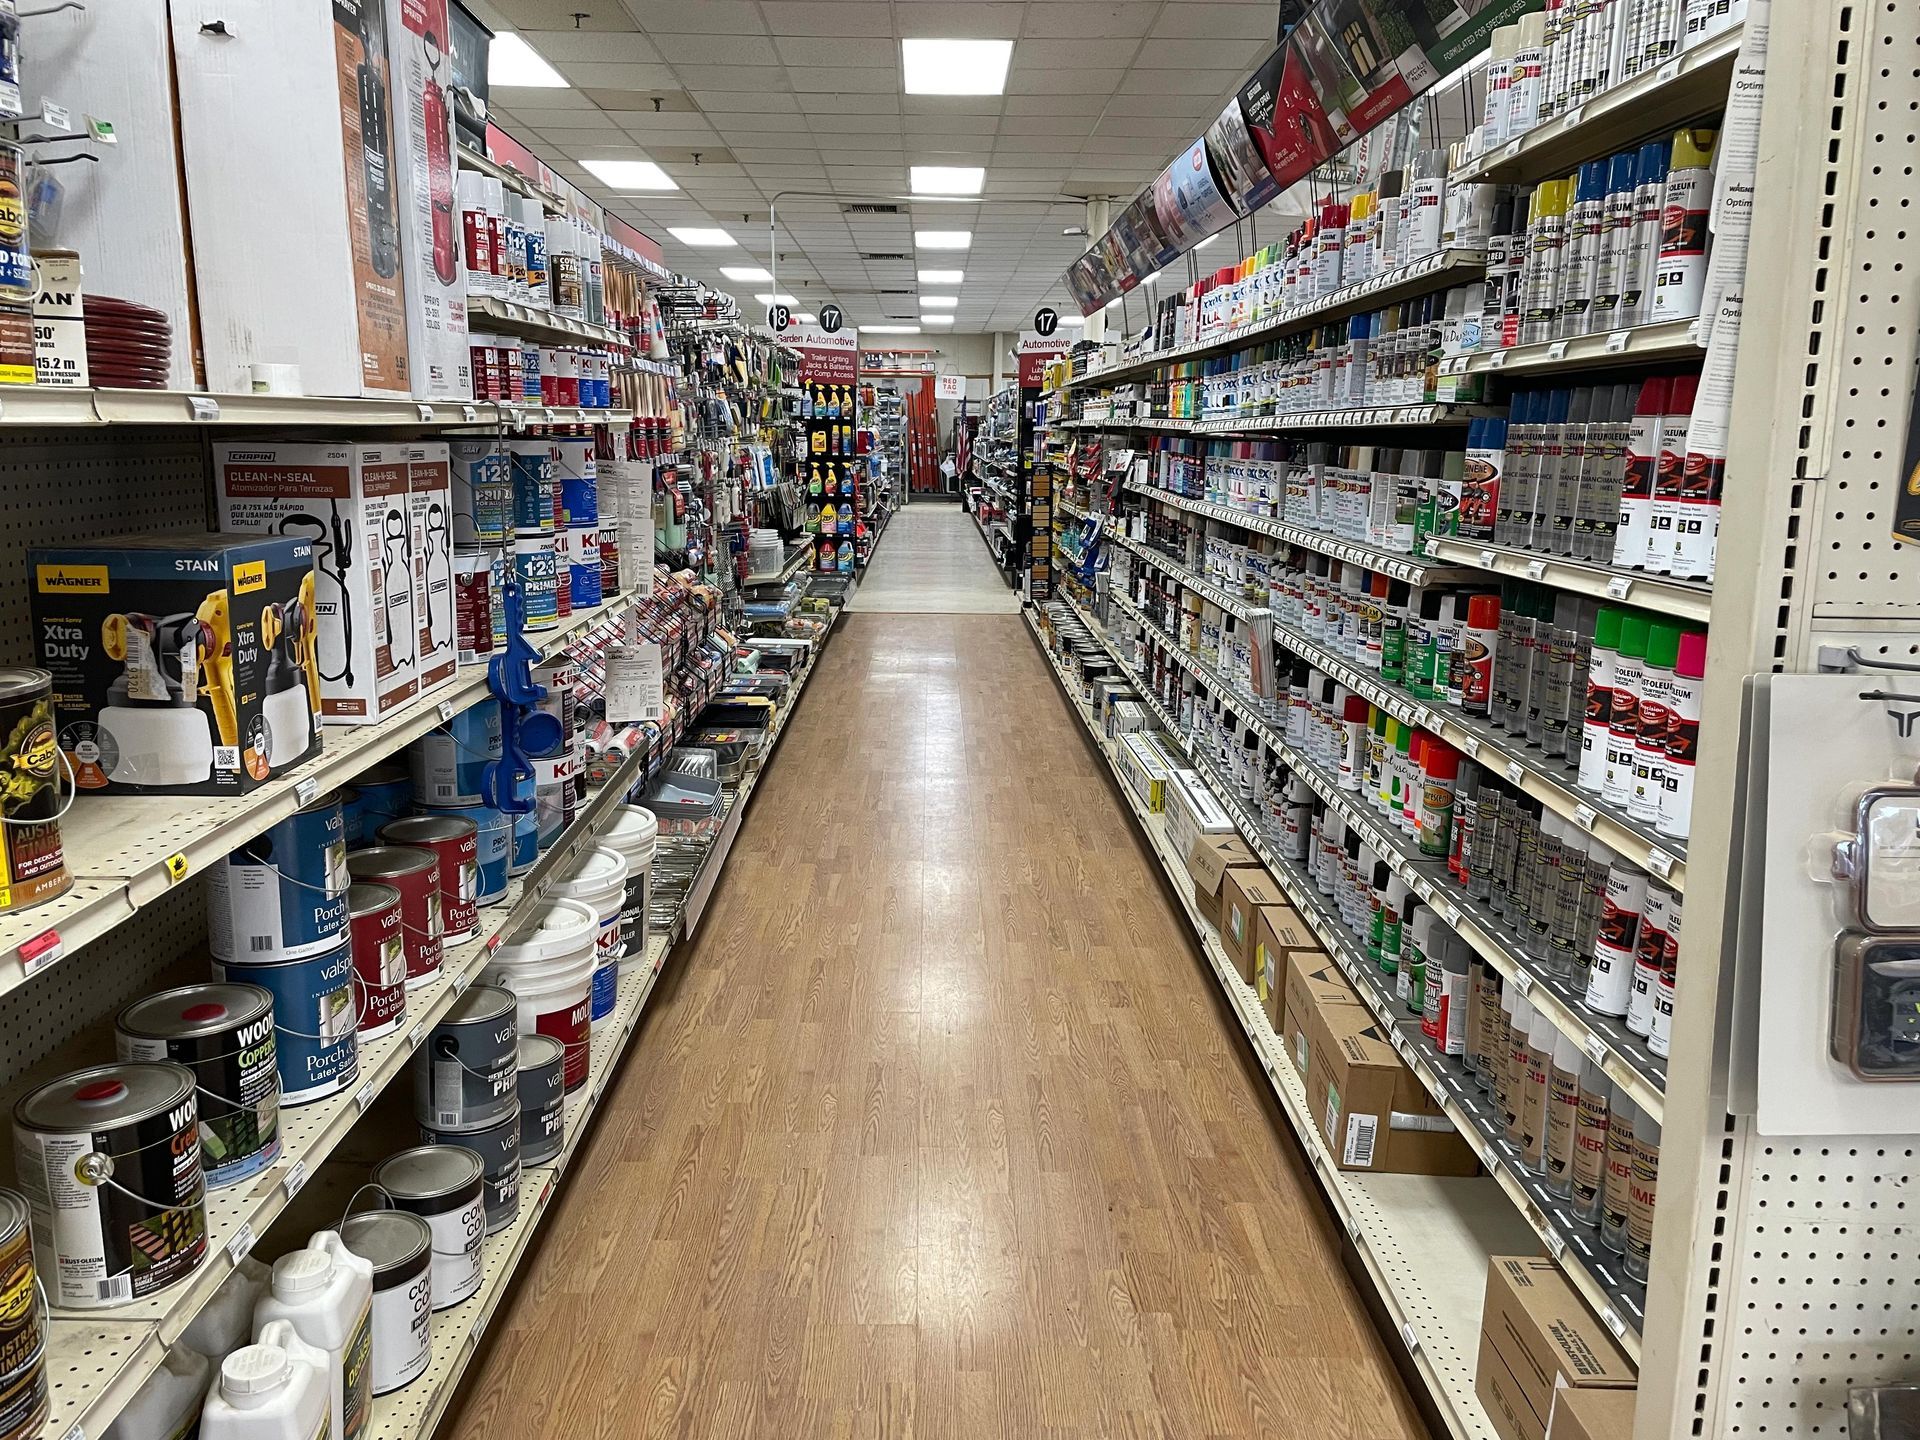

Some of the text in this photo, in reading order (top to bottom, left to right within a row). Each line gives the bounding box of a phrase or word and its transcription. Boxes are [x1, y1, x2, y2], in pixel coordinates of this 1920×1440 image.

[1443, 34, 1476, 62] FORMULATED
[1474, 26, 1488, 40] FOR
[1486, 8, 1511, 32] SPECIFIC
[1411, 68, 1429, 84] PAINTS
[822, 310, 839, 329] 17
[1038, 312, 1054, 332] 17
[776, 334, 855, 346] Garden Automotive
[1022, 339, 1071, 349] Automotive
[36, 357, 76, 370] 15.2 m
[811, 353, 850, 364] Trailer Lighting
[806, 362, 822, 370] Jacks
[829, 362, 854, 372] Batteries
[834, 371, 855, 379] Access.
[231, 452, 272, 460] CHAPIN
[230, 472, 317, 482] CLEAN-N-SEAL
[364, 470, 398, 482] CLEAN-N-SEAL
[231, 484, 277, 492] Atomizador
[278, 484, 298, 492] Para
[262, 502, 278, 511] MÁS
[279, 502, 304, 511] RÁPIDO
[294, 546, 312, 558] STAIN
[175, 559, 219, 572] STAIN
[46, 570, 102, 586] WAGNER
[237, 570, 263, 586] WAGNER
[430, 581, 448, 592] CHAPIN
[391, 594, 408, 606] CHAPIN
[44, 625, 82, 640] Xtra
[238, 630, 254, 646] Xtra
[44, 643, 90, 660] Duty
[238, 648, 258, 664] Duty
[18, 858, 32, 870] FOR
[24, 865, 39, 876] AND
[314, 906, 345, 924] Porch
[450, 906, 477, 922] Porch
[318, 921, 340, 934] Latex
[456, 918, 466, 928] Oil
[426, 954, 436, 966] Oil
[370, 986, 401, 1010] Porch
[378, 1006, 390, 1018] Oil
[306, 1047, 346, 1072] Porch
[240, 1066, 258, 1077] Green
[310, 1064, 338, 1082] Latex
[64, 1256, 104, 1265] RUST-OLEUM
